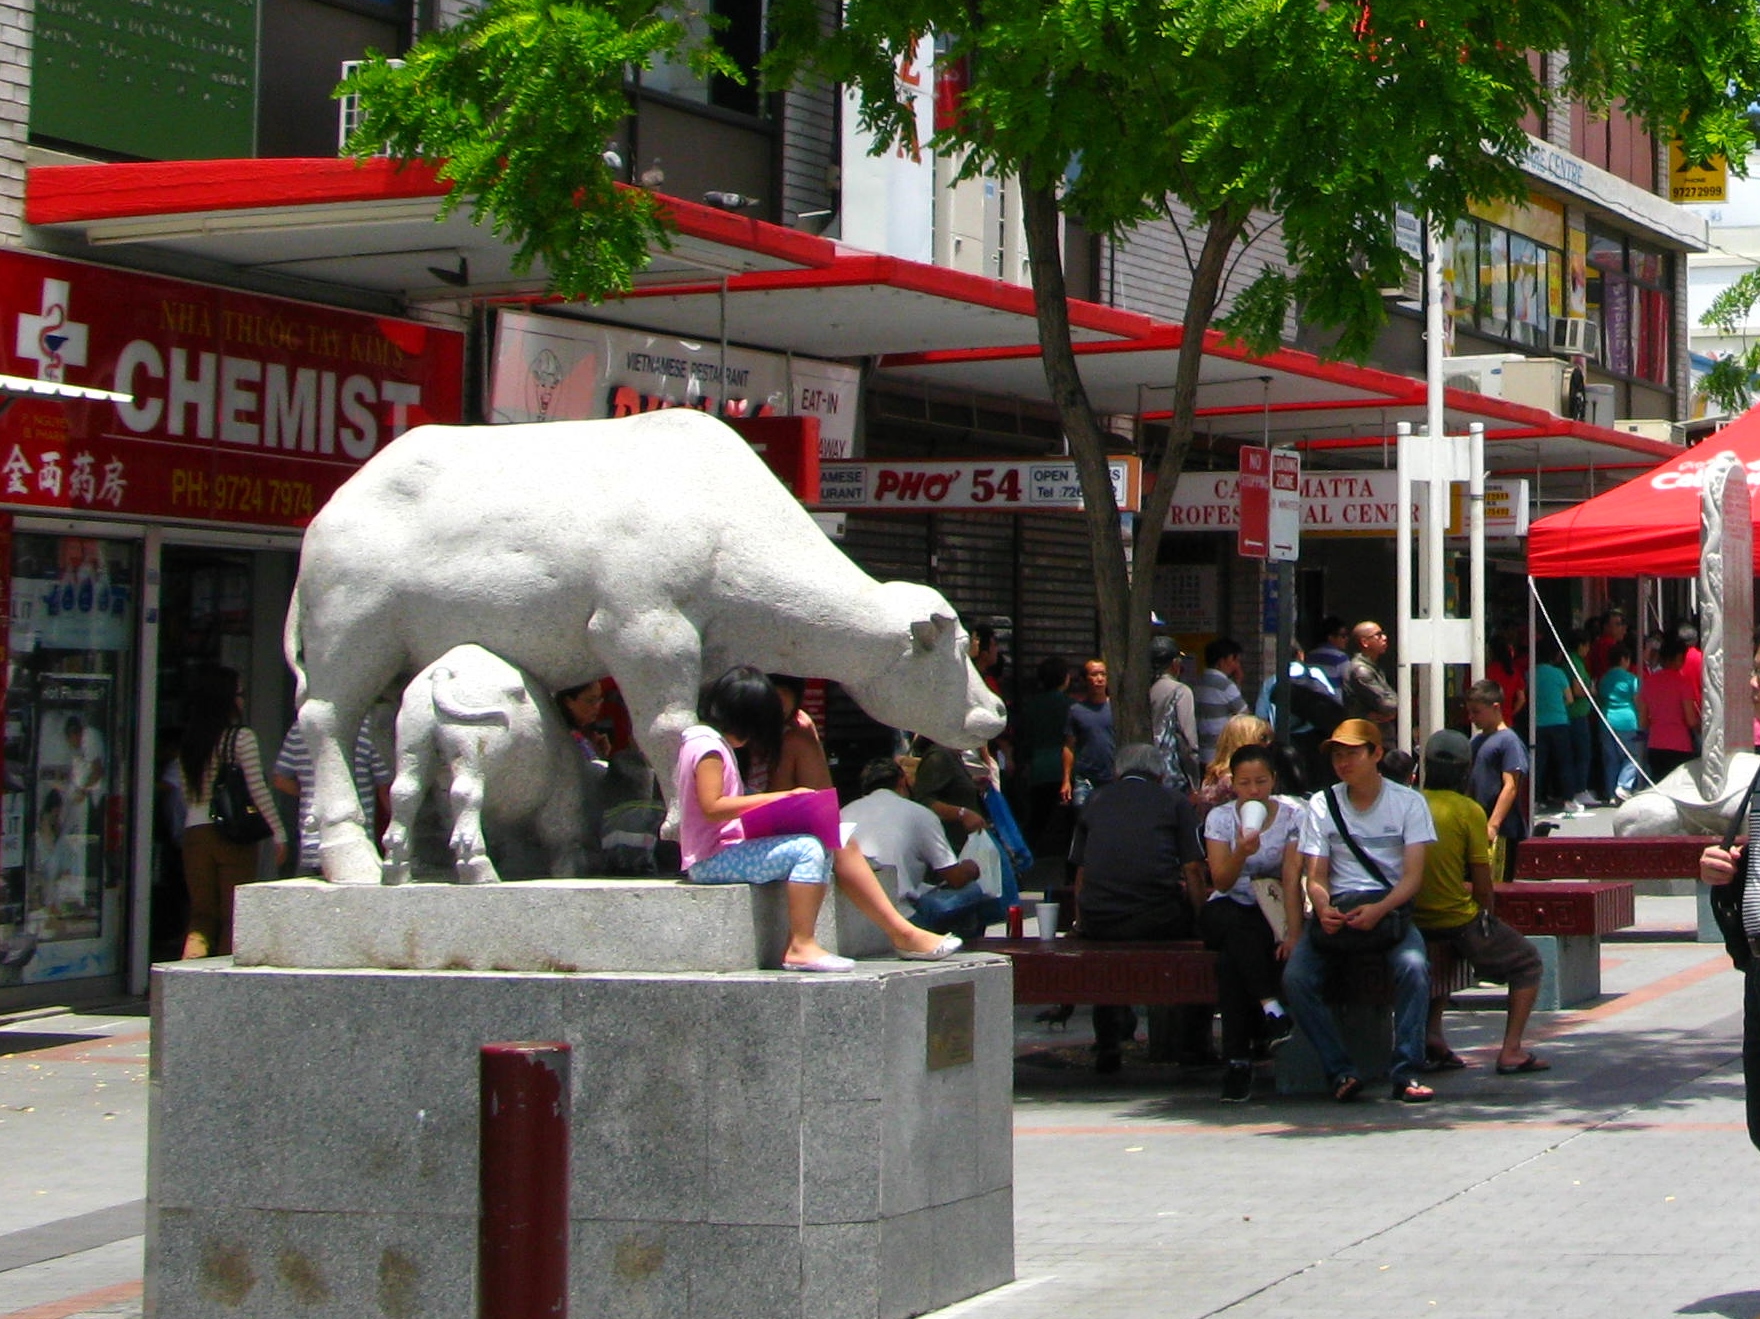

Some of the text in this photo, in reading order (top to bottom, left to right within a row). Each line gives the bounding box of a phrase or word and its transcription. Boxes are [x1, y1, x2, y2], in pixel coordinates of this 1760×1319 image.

[1548, 151, 1585, 186] CENTRE
[1672, 185, 1723, 198] 97272999
[626, 352, 688, 379] VIETNAMESE
[114, 339, 422, 460] CHEMIST
[801, 388, 839, 415] EAT-IN
[821, 470, 863, 483] AMESE
[970, 468, 1023, 503] 54
[1033, 469, 1070, 482] OPEN
[214, 473, 264, 513] 9724
[269, 480, 315, 516] 7974
[821, 486, 864, 500] URANT
[1036, 486, 1054, 498] Tel
[1213, 478, 1375, 500] CAMATTA
[1171, 503, 1334, 526] ROFESAL
[1341, 504, 1420, 525] CENTR
